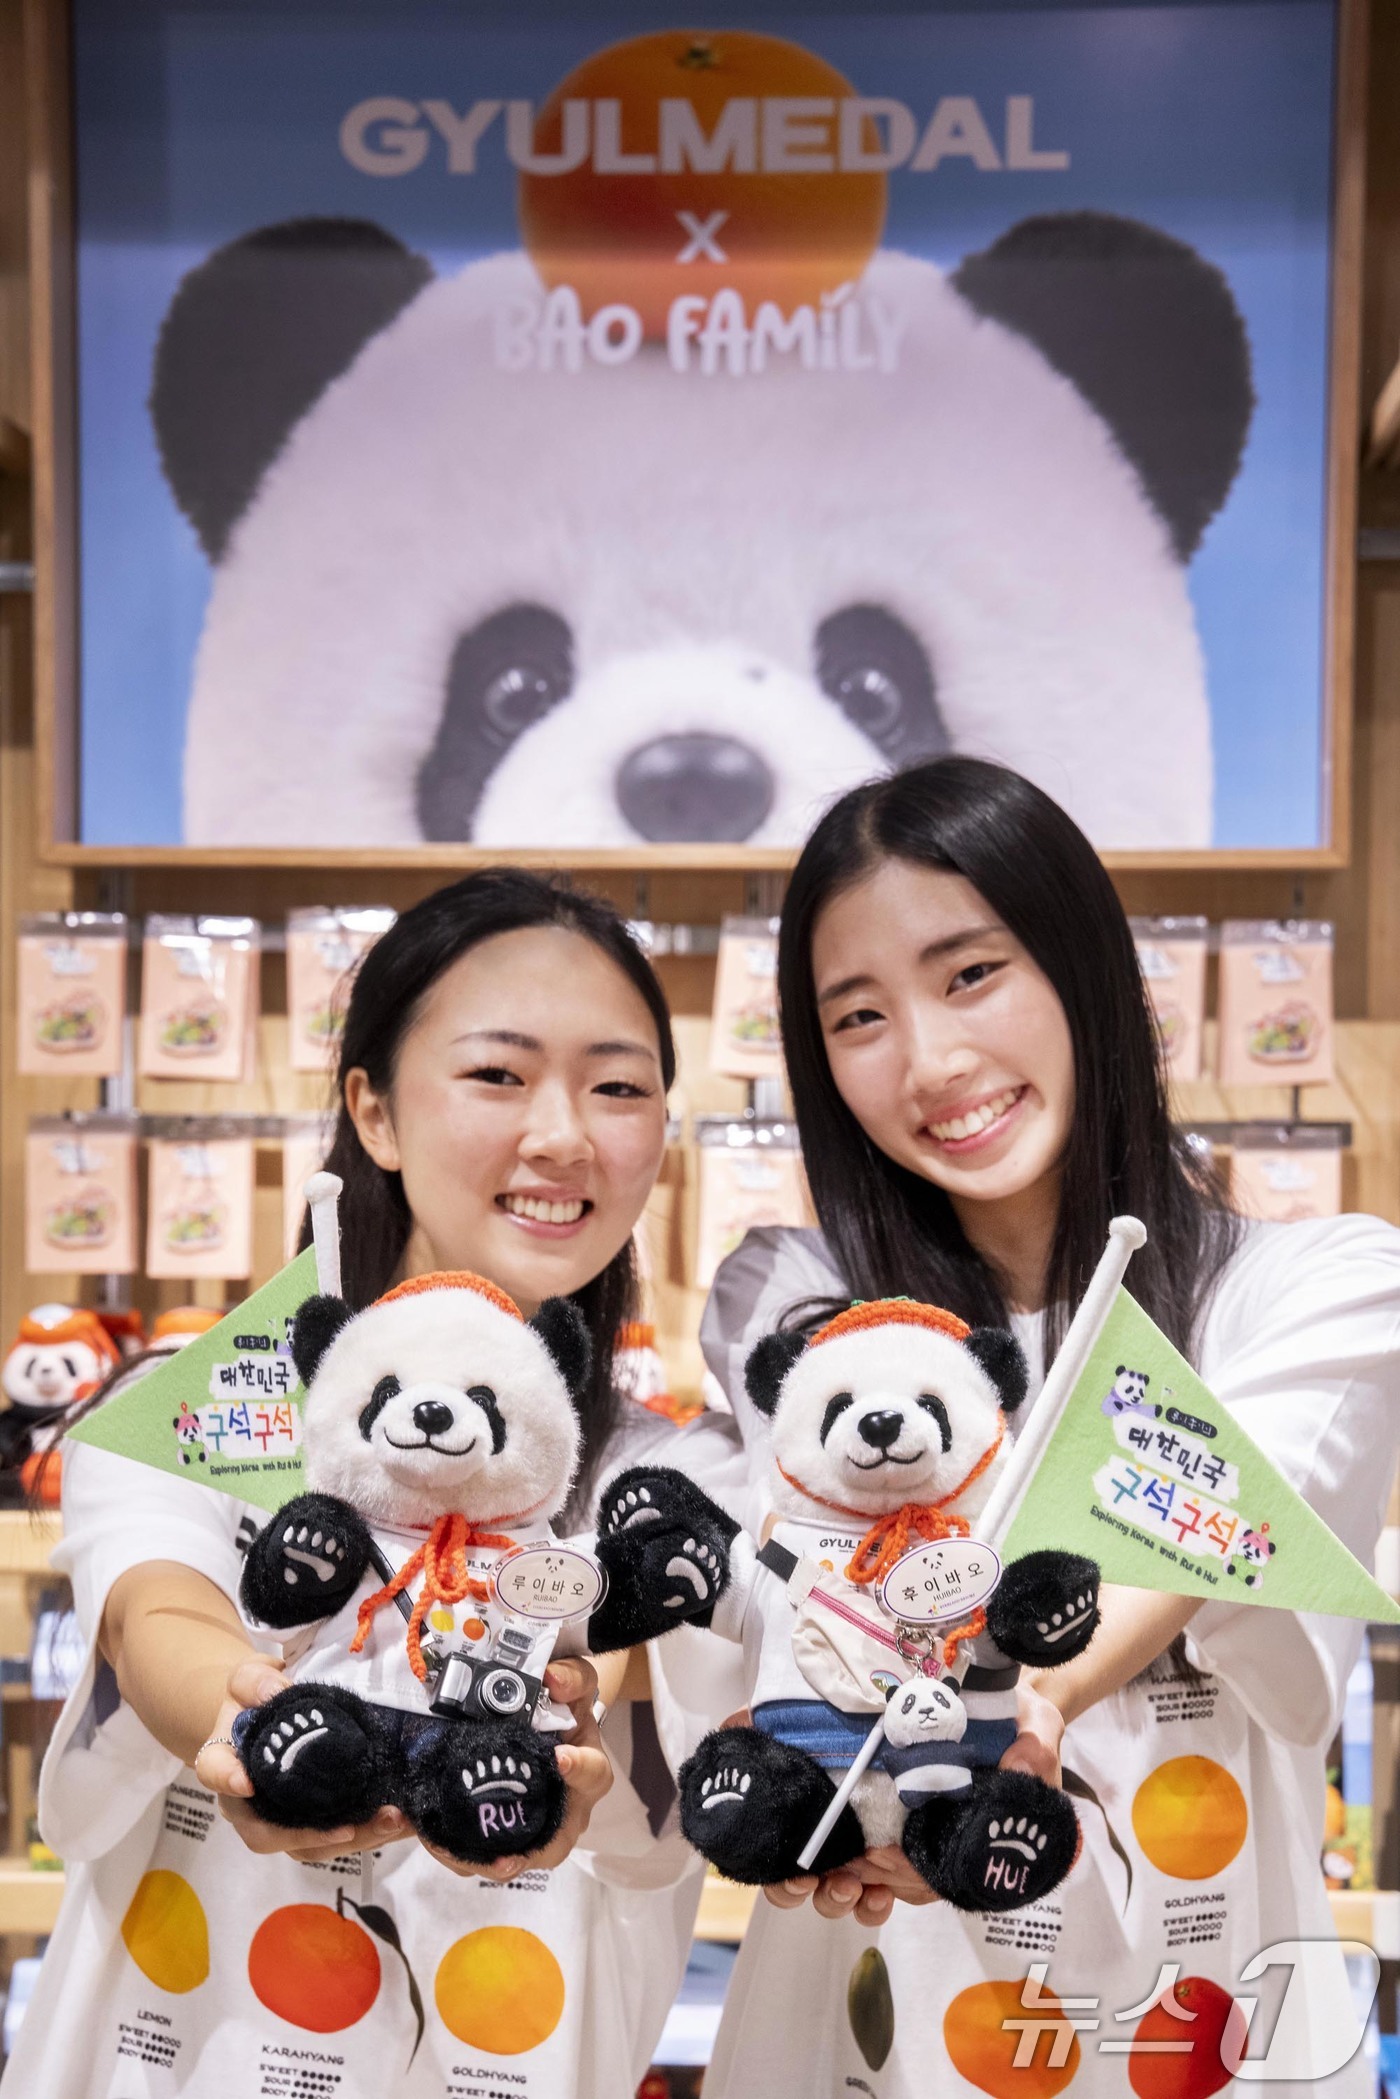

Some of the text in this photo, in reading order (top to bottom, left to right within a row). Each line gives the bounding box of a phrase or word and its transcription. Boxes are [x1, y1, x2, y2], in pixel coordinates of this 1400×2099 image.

[340, 97, 1070, 176] GYULMEDAL
[495, 284, 642, 376] BAO
[220, 1359, 290, 1394] 대한민국
[206, 1401, 293, 1451] 구석구석
[1128, 1427, 1227, 1489] 대한민국
[1111, 1464, 1239, 1555] 구석구석
[1090, 1505, 1129, 1536] Exploring
[1130, 1528, 1155, 1549] Korea
[933, 1586, 963, 1602] HUIBAO
[1148, 1691, 1183, 1702] SWEET
[1156, 1703, 1180, 1712] SOUR
[1156, 1714, 1179, 1723] BODY
[984, 1855, 1030, 1894] HUI
[1165, 1893, 1225, 1909] GOLDHYANG
[1163, 1916, 1193, 1927] SWEET
[988, 1925, 1015, 1936] SOUR
[1168, 1927, 1189, 1937] SOUR
[985, 1936, 1013, 1947] BODY
[1167, 1938, 1187, 1948] BODY
[137, 2008, 172, 2027] LEMON
[262, 2044, 345, 2065] KARAHYANG
[260, 2063, 298, 2076] SWEET
[452, 2066, 527, 2084] GOLDHYANG
[264, 2076, 290, 2086] SOUR
[261, 2086, 288, 2097] BODY
[447, 2085, 486, 2097] SWEET
